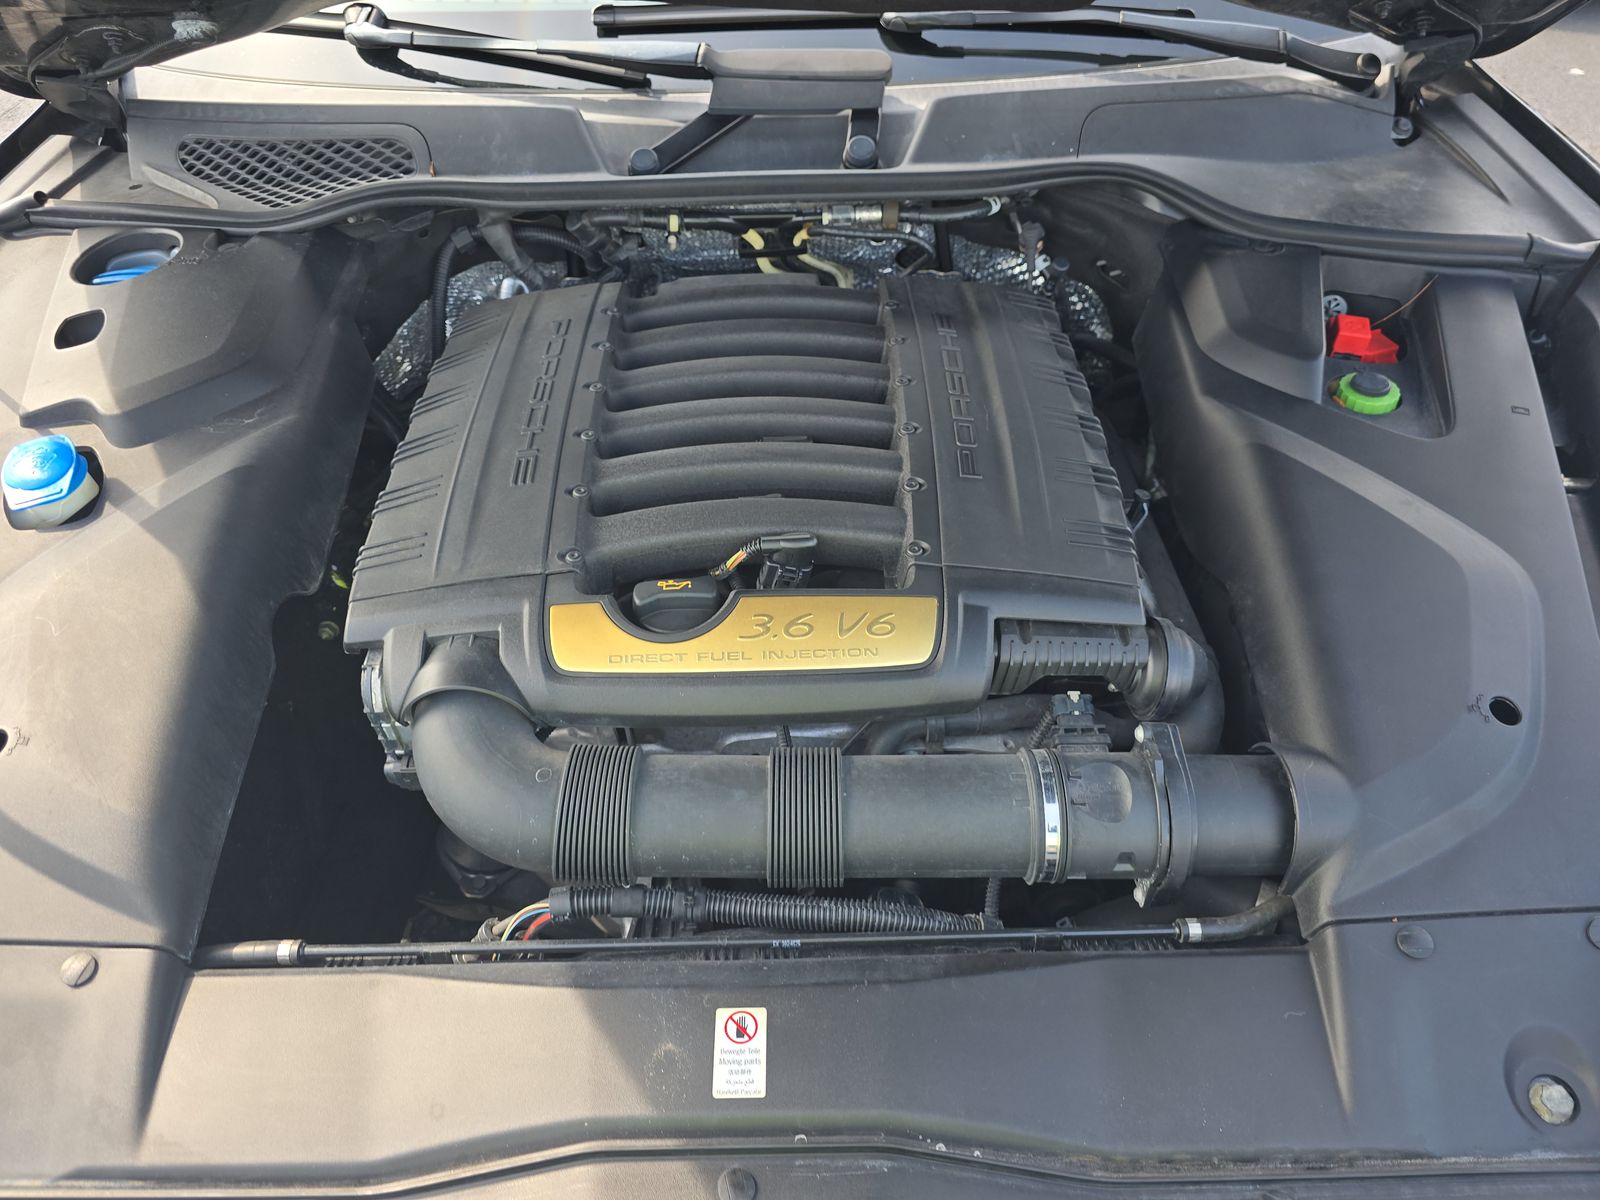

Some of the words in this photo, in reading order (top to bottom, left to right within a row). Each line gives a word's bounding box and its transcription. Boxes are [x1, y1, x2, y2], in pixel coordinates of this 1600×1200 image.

[510, 318, 573, 487] PORSCHE
[934, 312, 984, 480] PORSCHE
[737, 609, 815, 642] 3.6
[836, 609, 897, 640] V6
[607, 651, 688, 665] DIRECT
[697, 649, 753, 662] FUEL
[762, 646, 880, 660] INJECTION
[718, 1057, 743, 1067] Moving
[744, 1058, 762, 1067] parts
